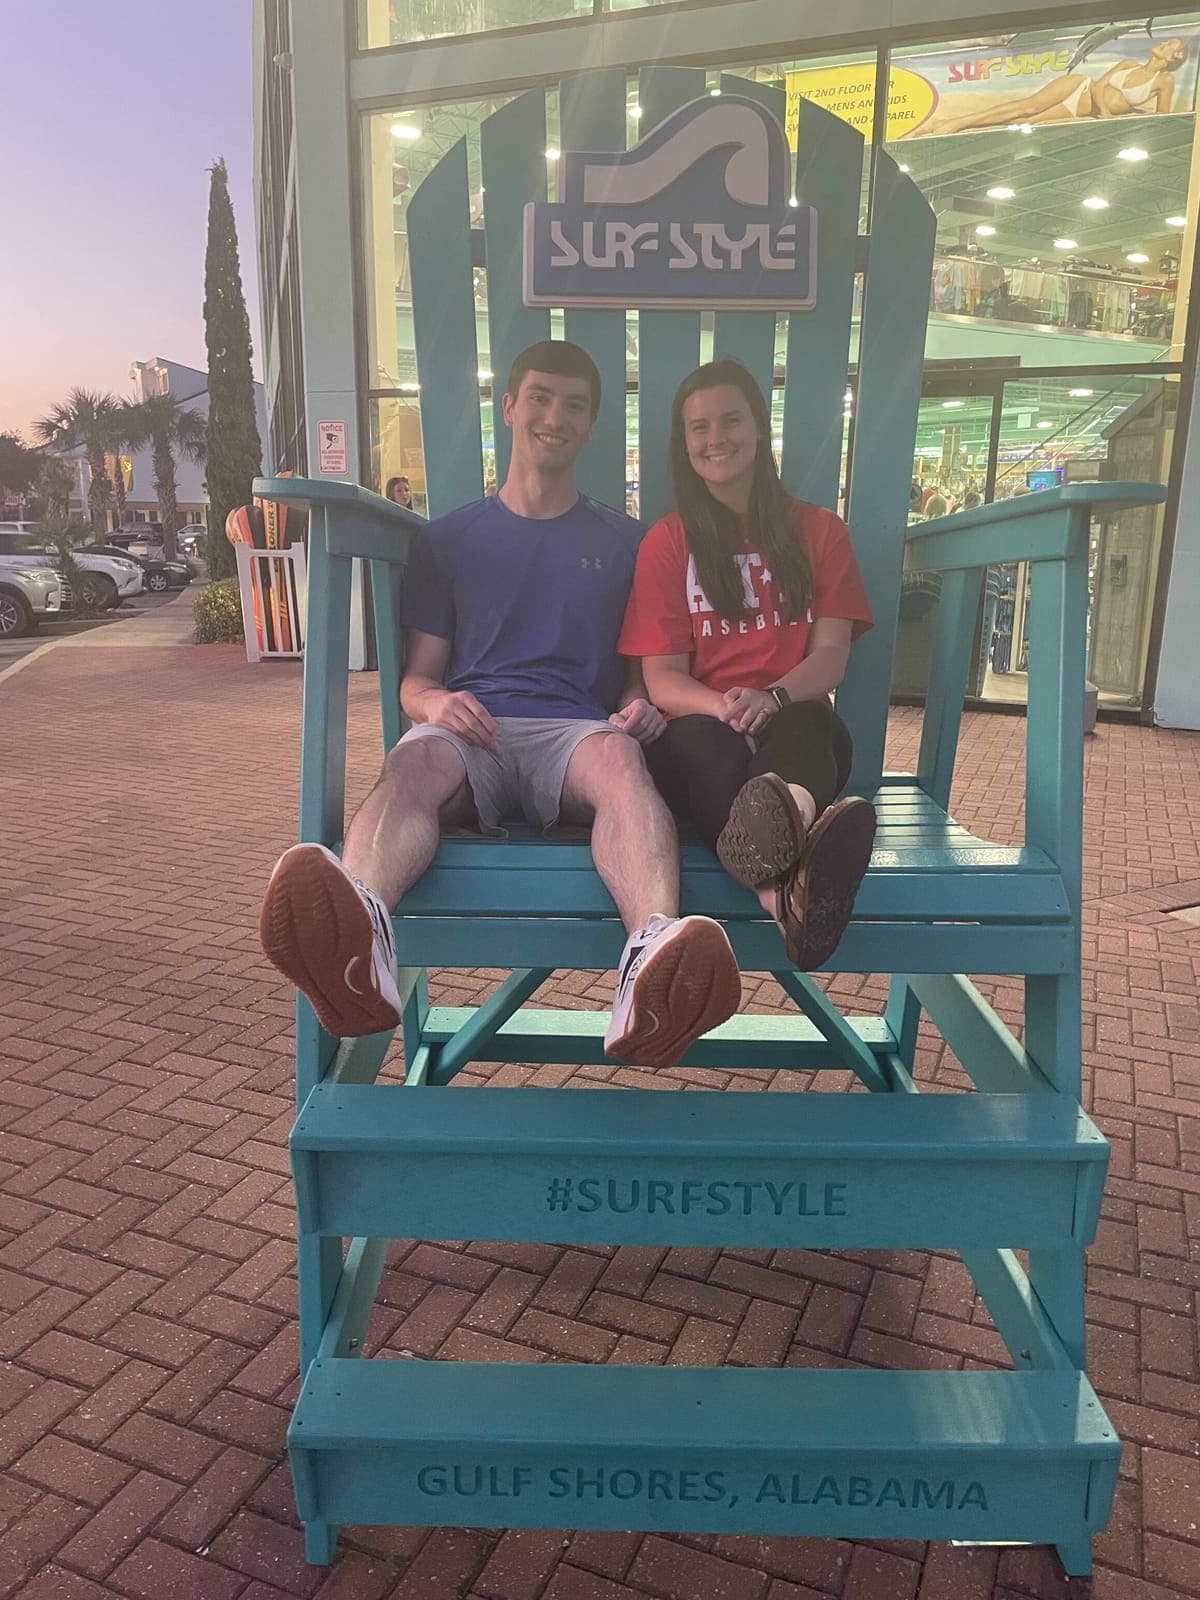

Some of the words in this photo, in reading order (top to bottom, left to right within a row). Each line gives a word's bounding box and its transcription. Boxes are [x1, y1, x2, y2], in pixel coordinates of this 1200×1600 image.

[948, 57, 1001, 83] SURF
[1005, 50, 1069, 77] STYLE
[815, 87, 836, 98] 2ND
[838, 83, 872, 95] FLOOR
[827, 101, 857, 112] MENS
[857, 99, 873, 108] AN
[887, 95, 907, 105] IDS
[871, 110, 916, 122] PAREL
[550, 221, 659, 268] SURF
[669, 222, 796, 270] STYLE
[546, 1177, 848, 1217] #SURFSTYLE
[416, 1464, 533, 1497] GULF
[547, 1466, 739, 1509] SHORES,
[755, 1472, 990, 1512] ALABAMA
